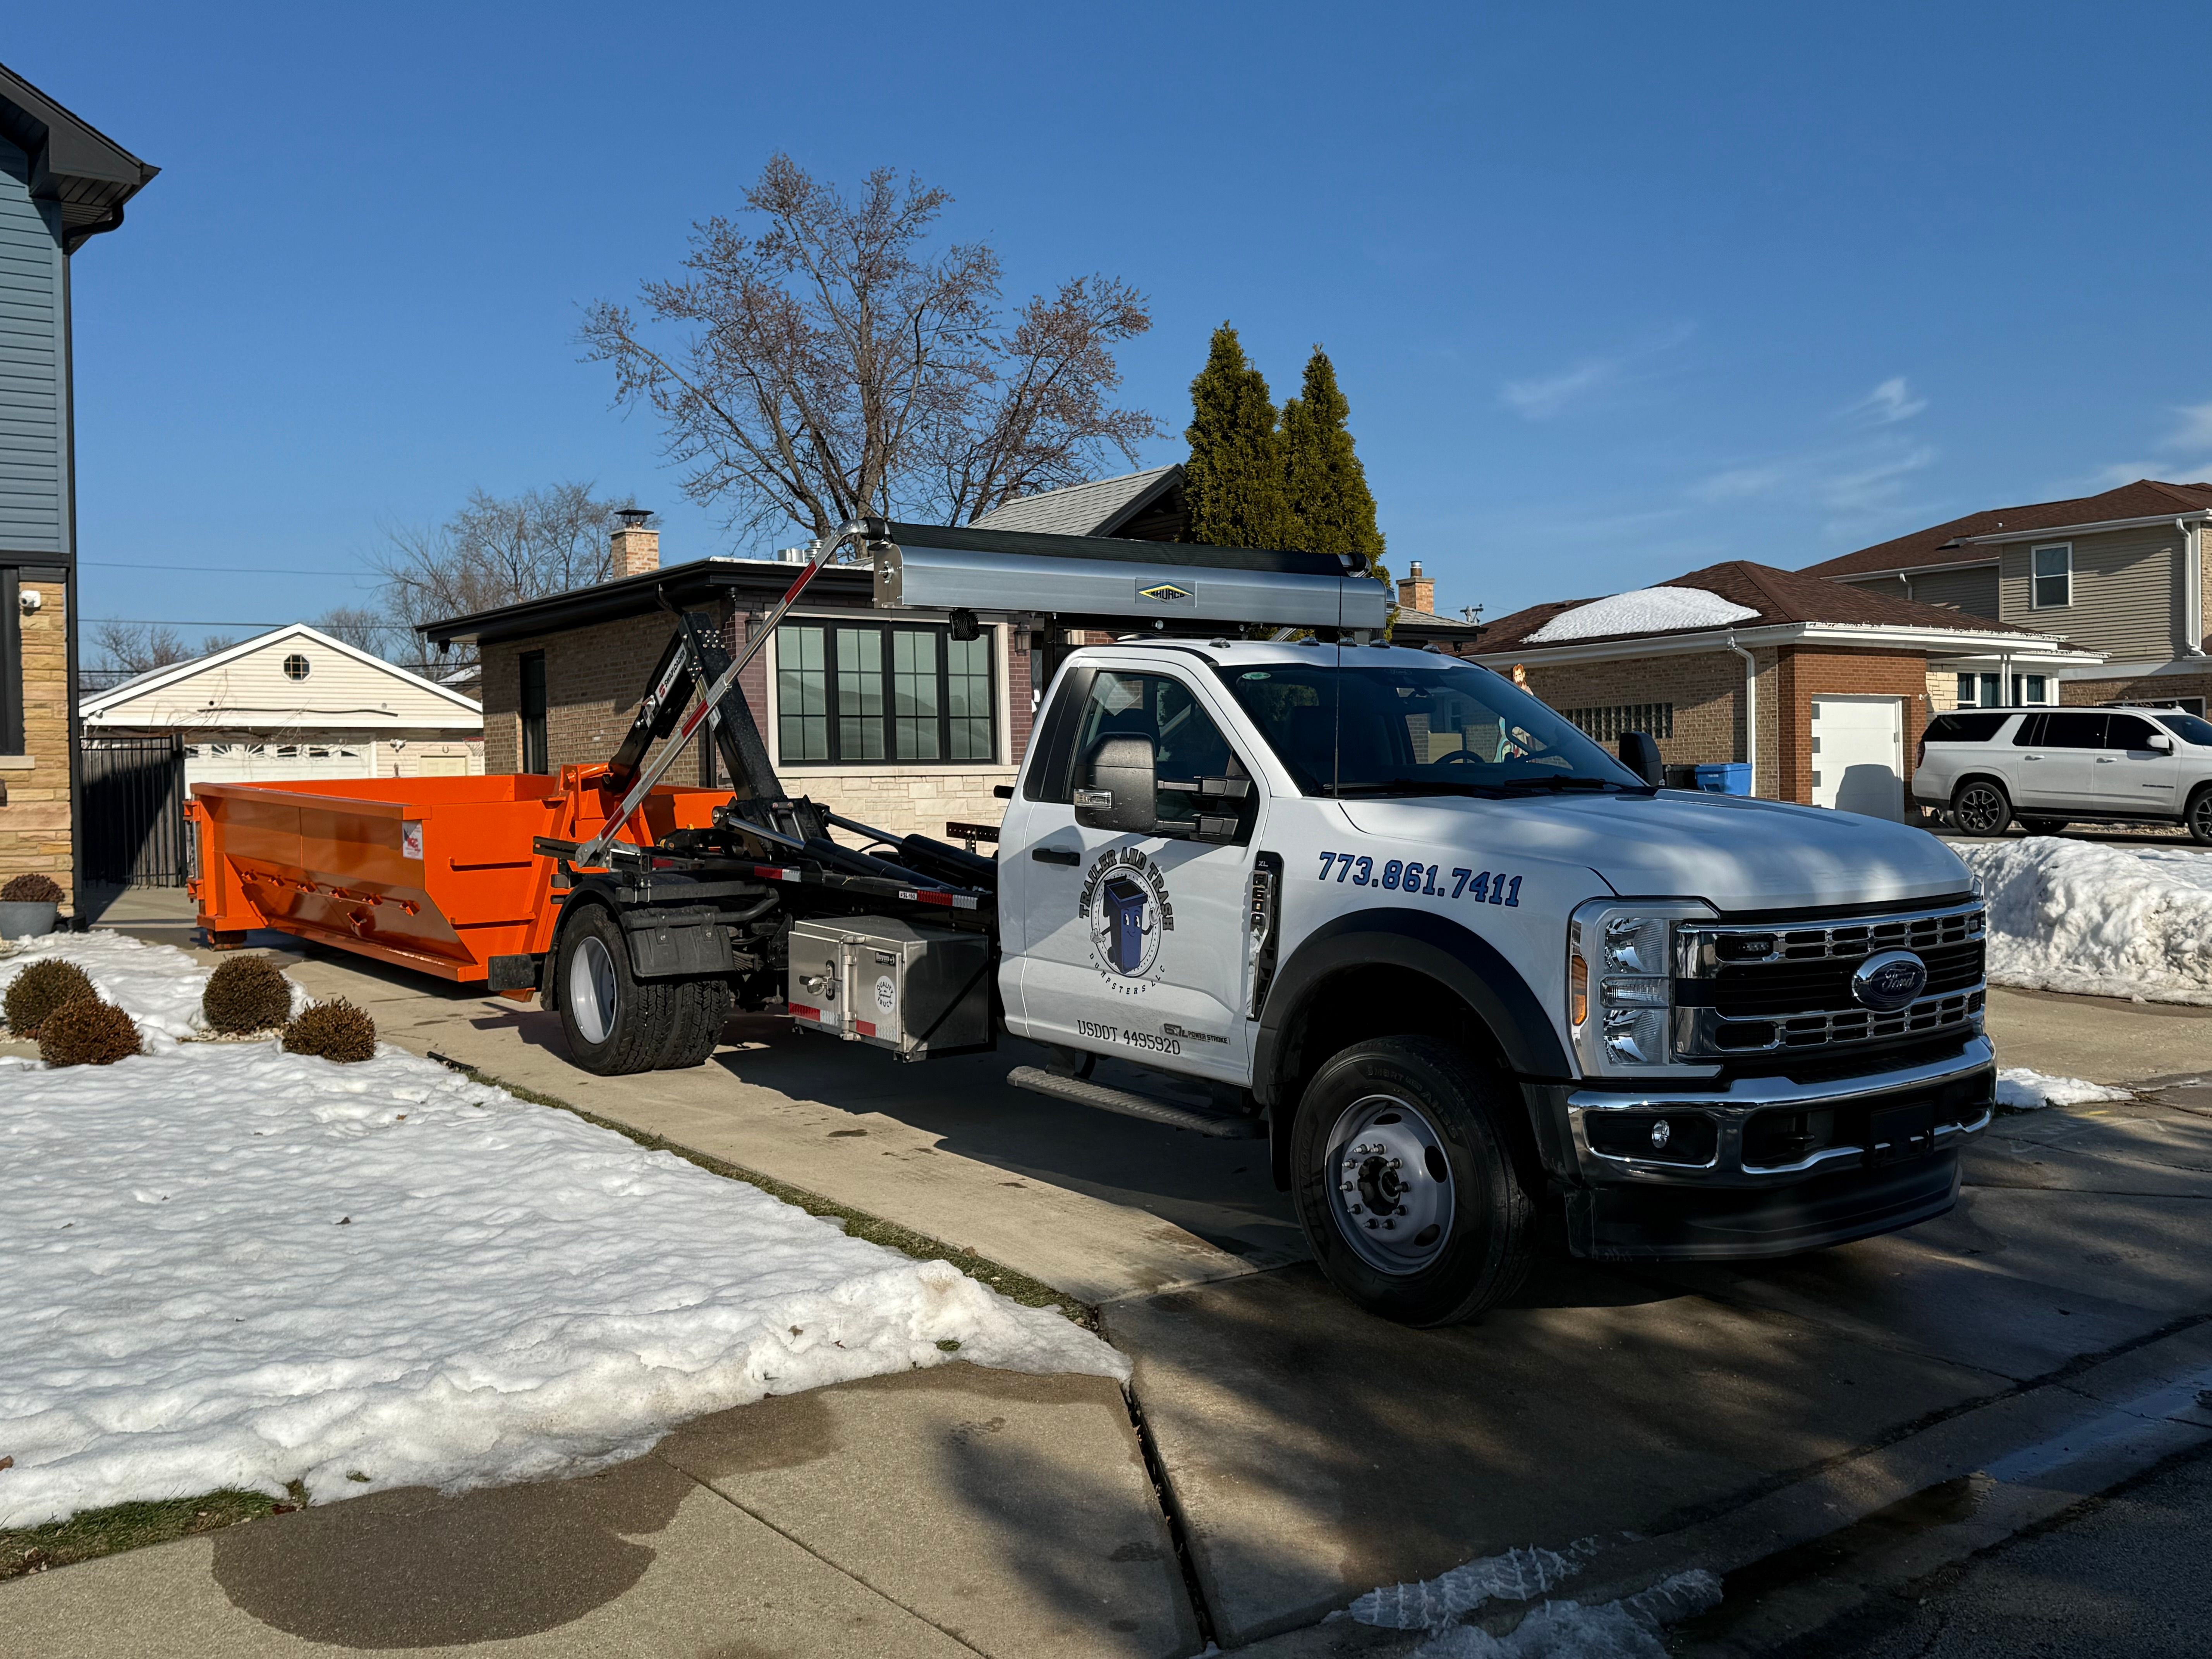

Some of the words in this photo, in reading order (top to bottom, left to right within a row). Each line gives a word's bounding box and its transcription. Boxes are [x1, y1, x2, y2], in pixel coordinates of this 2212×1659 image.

[1079, 849, 1117, 919] TRAILER
[1120, 847, 1147, 871] AND
[1147, 861, 1174, 931] TRASH
[1319, 851, 1523, 908] 773.861.7411
[1089, 953, 1146, 995] DUMPSTERS
[1151, 965, 1165, 987] LLC
[1882, 968, 1915, 991] Ford
[1077, 1020, 1118, 1042] USDOT
[1123, 1030, 1180, 1055] 4495920
[1188, 1030, 1206, 1040] POWER
[1206, 1034, 1228, 1044] STROKE
